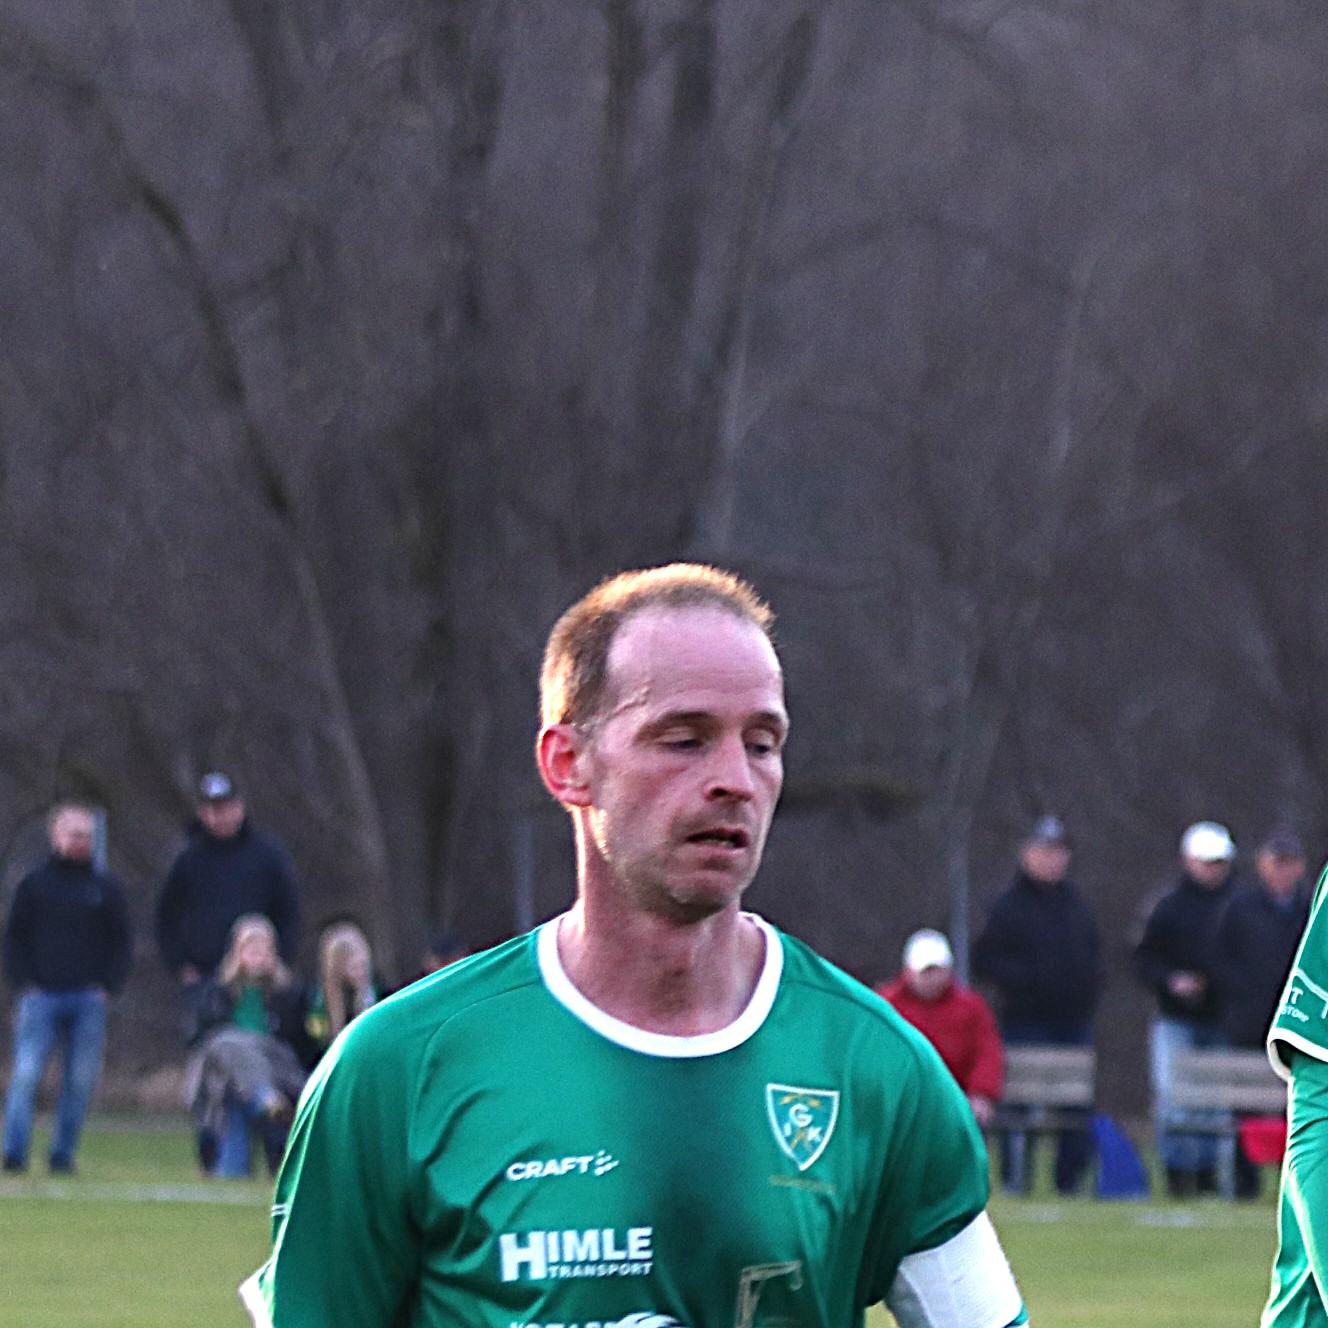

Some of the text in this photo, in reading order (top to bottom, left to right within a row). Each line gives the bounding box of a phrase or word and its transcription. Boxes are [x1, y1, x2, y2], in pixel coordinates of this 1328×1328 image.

[506, 1155, 595, 1183] CRAFT
[499, 1226, 655, 1282] HIMLE
[547, 1262, 654, 1280] TRANSPORT
